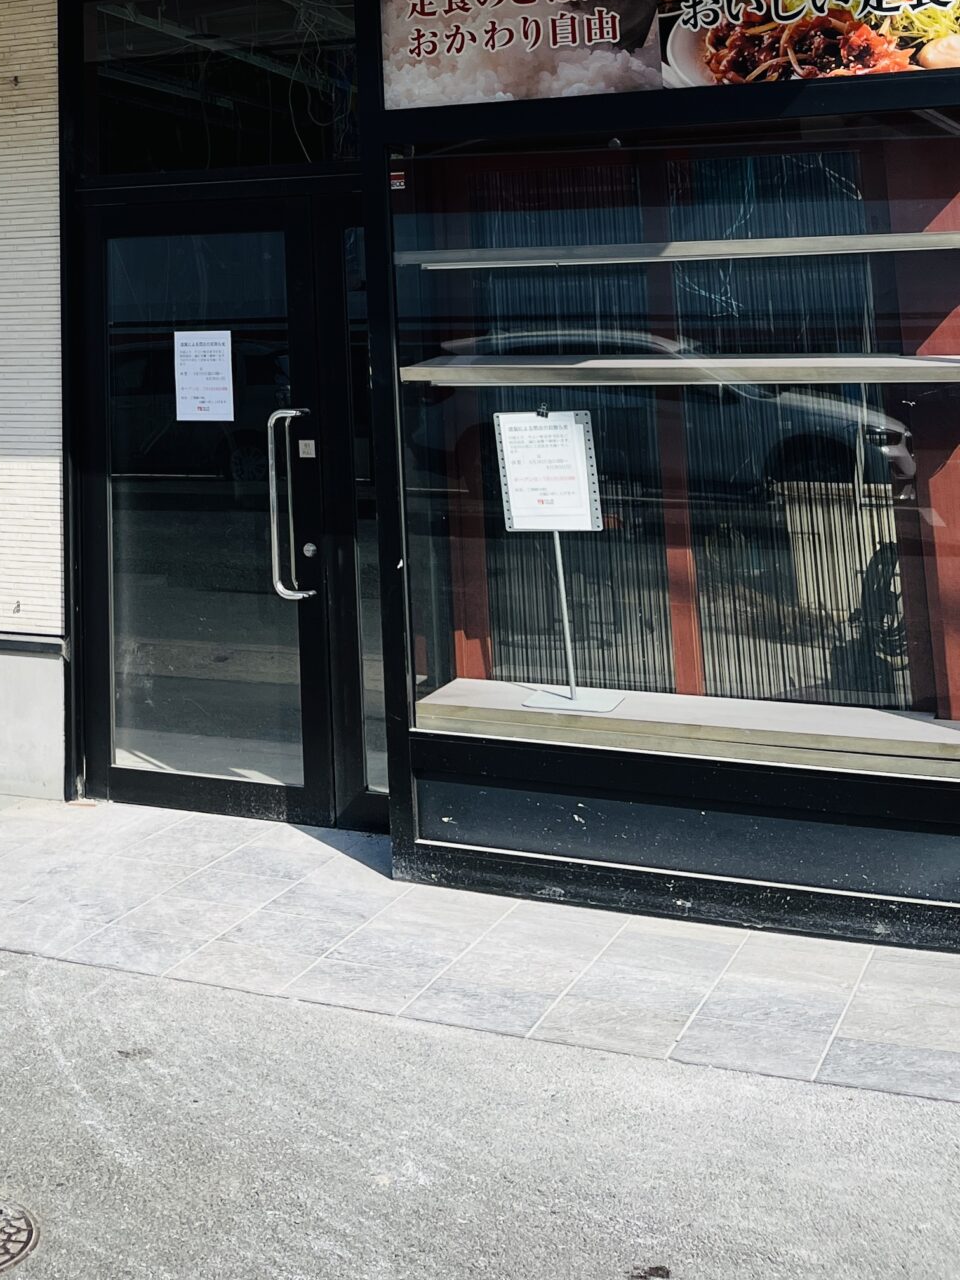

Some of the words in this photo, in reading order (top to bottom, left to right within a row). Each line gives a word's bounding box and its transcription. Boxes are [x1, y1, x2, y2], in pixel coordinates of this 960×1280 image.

[408, 9, 620, 58] おかわり自由
